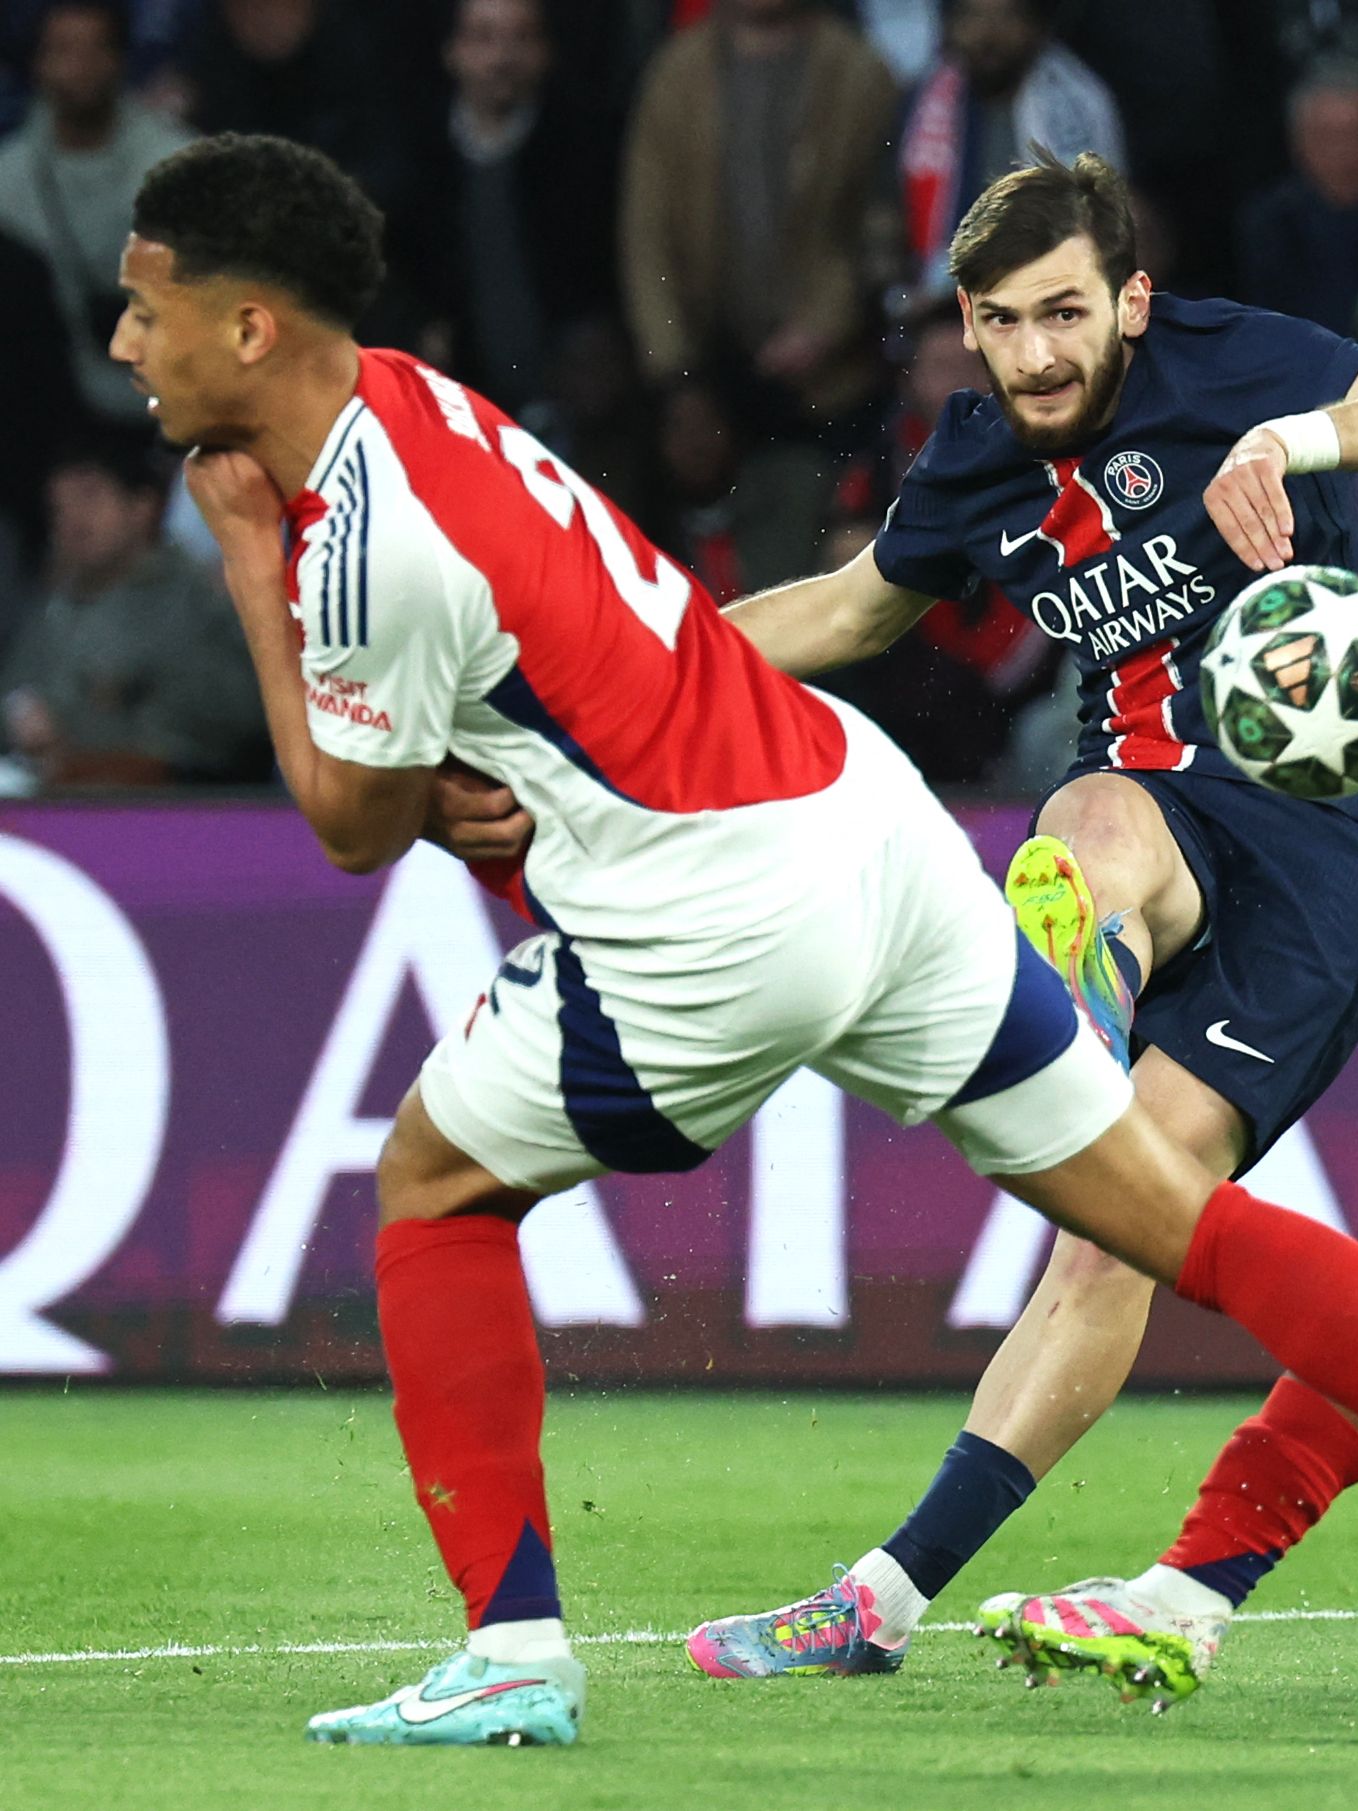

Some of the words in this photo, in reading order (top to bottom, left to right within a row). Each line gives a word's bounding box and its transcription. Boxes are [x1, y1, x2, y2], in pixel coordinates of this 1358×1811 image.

[1107, 454, 1142, 477] PARIS
[497, 424, 692, 653] 2
[1031, 534, 1198, 644] QATAR
[1087, 574, 1216, 661] AIRWAYS
